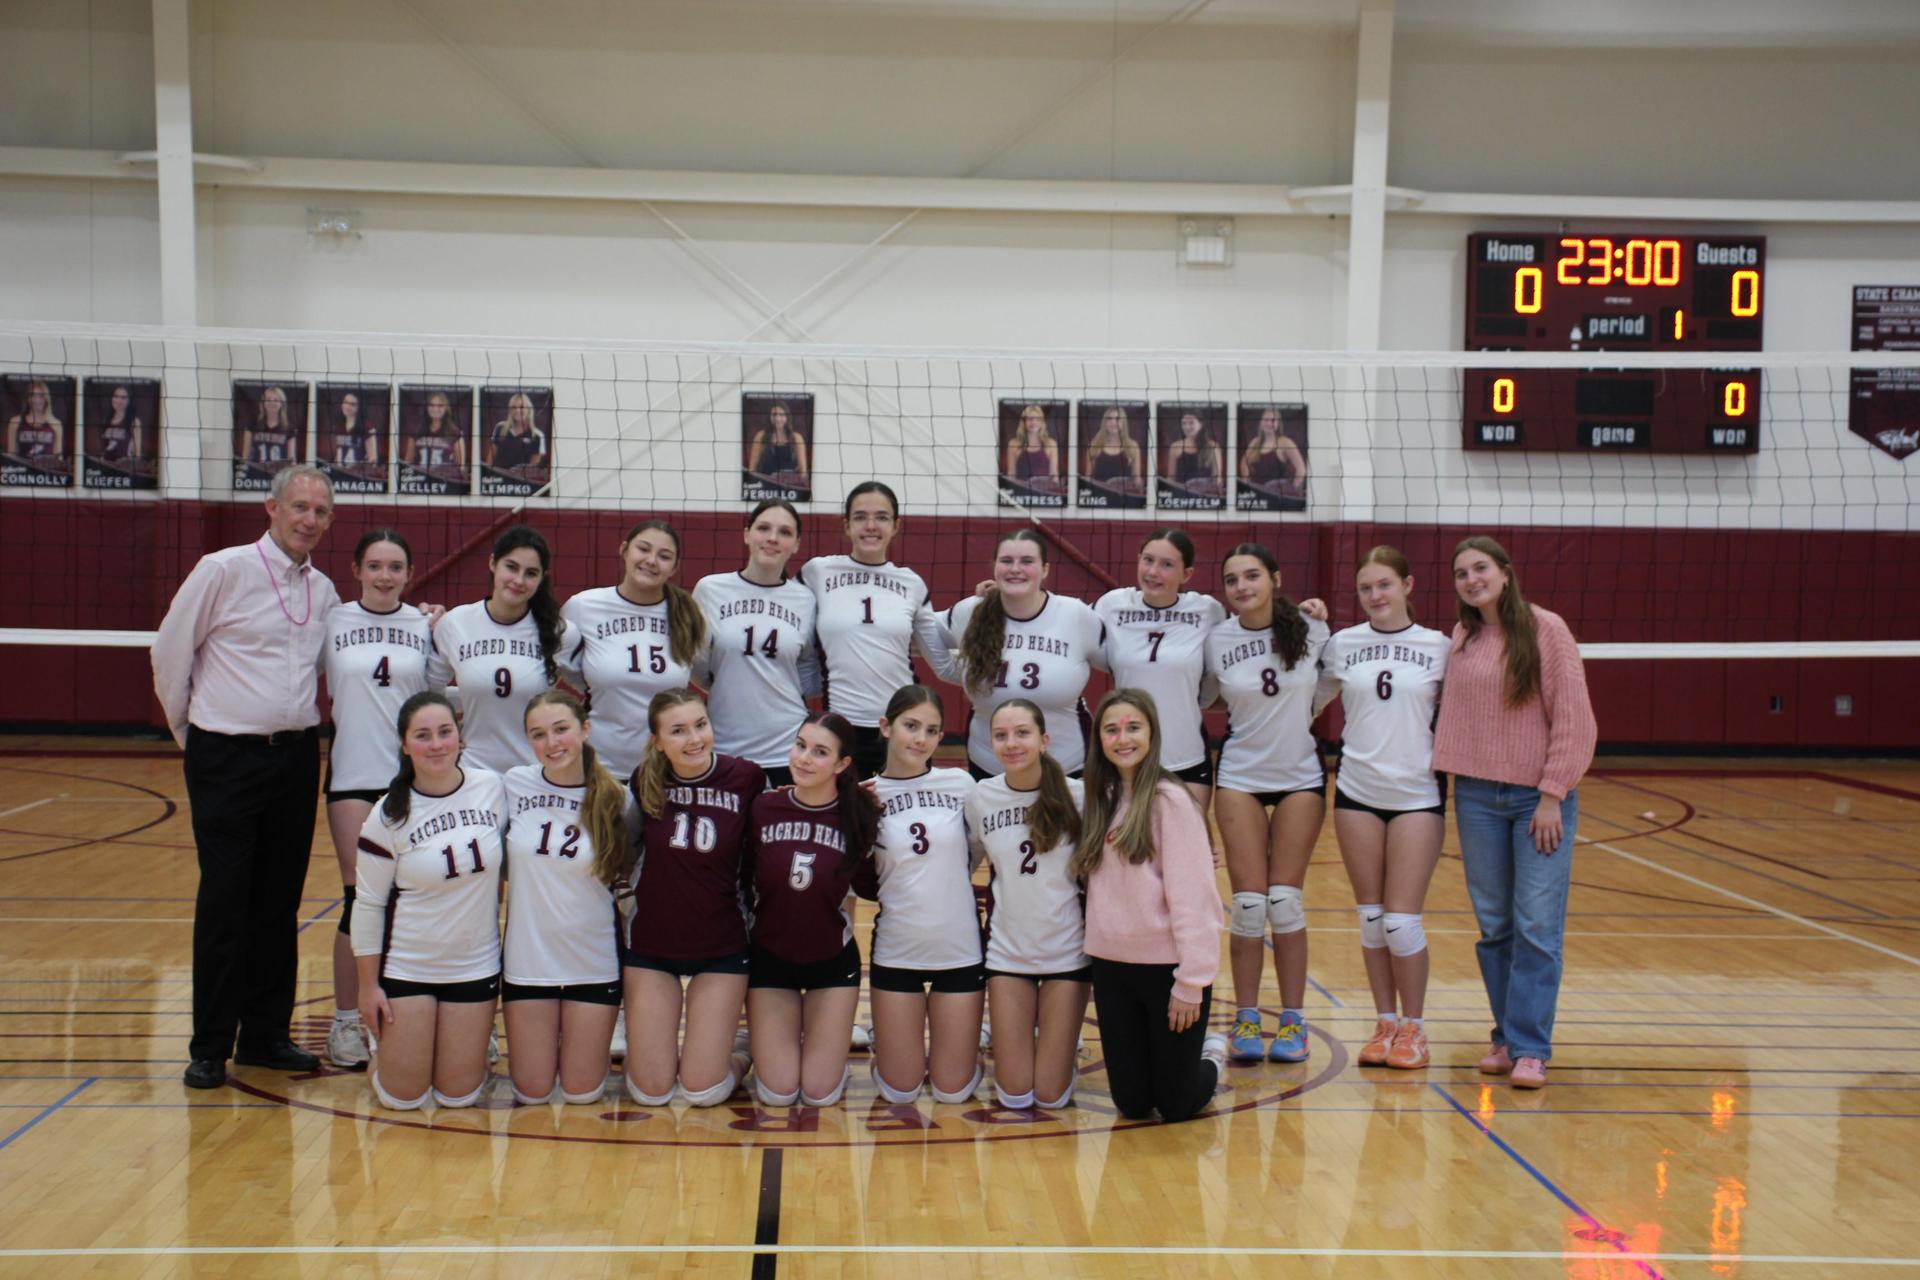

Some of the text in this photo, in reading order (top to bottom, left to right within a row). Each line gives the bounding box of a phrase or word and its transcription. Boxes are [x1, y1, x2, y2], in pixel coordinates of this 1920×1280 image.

[1486, 240, 1535, 262] Home
[1557, 238, 1680, 286] 23:00
[1697, 242, 1758, 266] Guests
[1515, 267, 1542, 314] 0
[1731, 270, 1759, 317] 0
[1856, 287, 1889, 301] STATE
[1588, 314, 1646, 339] period
[1673, 309, 1684, 341] 1
[1493, 378, 1515, 413] 0
[1724, 382, 1746, 417] 0
[1482, 425, 1516, 441] won
[1592, 427, 1635, 447] game
[1713, 428, 1746, 445] won
[0, 474, 67, 485] CONNOLLY
[86, 476, 131, 487] KIEFER
[235, 478, 270, 489] DONN
[334, 480, 384, 492] ANAGAN
[400, 482, 447, 493] KELLEY
[482, 484, 531, 495] LEMPKO
[825, 572, 908, 599] SACRED HEART
[719, 598, 801, 632] SACRED HEART
[861, 596, 874, 624] 1
[335, 627, 427, 656] SACRED HEART
[597, 616, 645, 640] SACRED
[743, 625, 778, 659] 14
[459, 638, 542, 662] SACRED HEAR
[627, 643, 667, 674] 15
[1028, 634, 1069, 658] HEART
[1148, 631, 1166, 663] 7
[1221, 638, 1266, 671] SACRED
[1344, 644, 1433, 672] SACRED HEART
[373, 655, 391, 688] 4
[494, 667, 512, 698] 9
[994, 661, 1041, 690] 13
[1261, 667, 1279, 698] 8
[1376, 670, 1393, 701] 6
[696, 787, 740, 813] HEART
[409, 812, 457, 849] SACRED
[535, 821, 582, 860] 12
[669, 811, 718, 854] 10
[760, 821, 811, 844] SACRED
[909, 822, 930, 855] 3
[441, 838, 486, 880] 11
[789, 850, 817, 892] 5
[1019, 839, 1038, 876] 2
